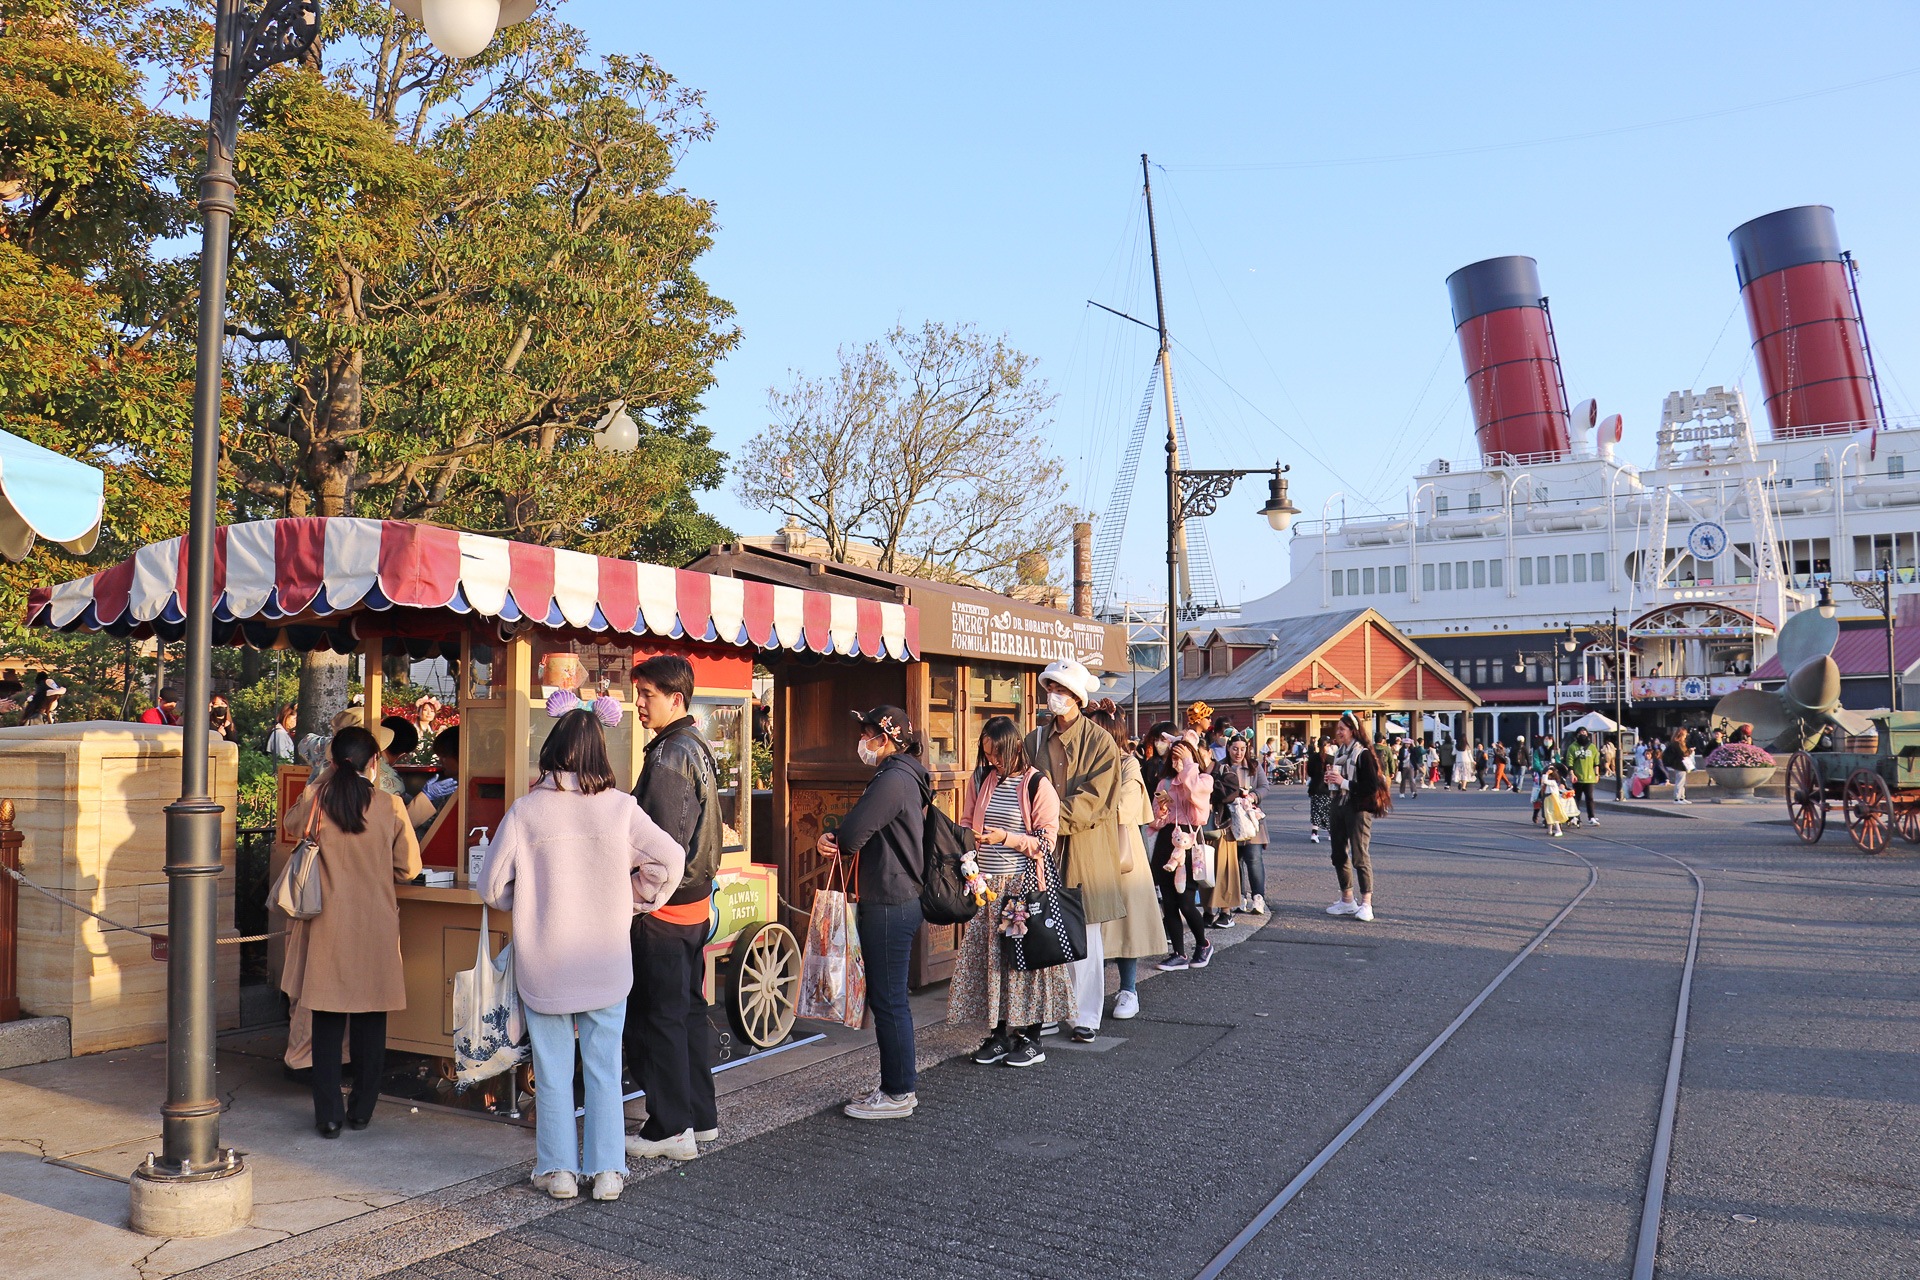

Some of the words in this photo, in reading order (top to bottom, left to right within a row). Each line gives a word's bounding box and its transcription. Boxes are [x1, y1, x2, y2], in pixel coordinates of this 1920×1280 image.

[1656, 422, 1746, 446] STEAMSHIP
[951, 601, 957, 611] A
[957, 602, 990, 616] PATENTED
[951, 612, 990, 635] ENERGY
[1012, 617, 1024, 630] DR.
[1024, 618, 1054, 635] HOBART'S
[951, 633, 990, 653] FORMULA
[991, 631, 1038, 658] HERBAL
[1039, 638, 1076, 661] ELIXIR
[1073, 631, 1104, 651] VITALITY
[728, 891, 759, 907] ALWAYS
[732, 905, 756, 920] TASTY
